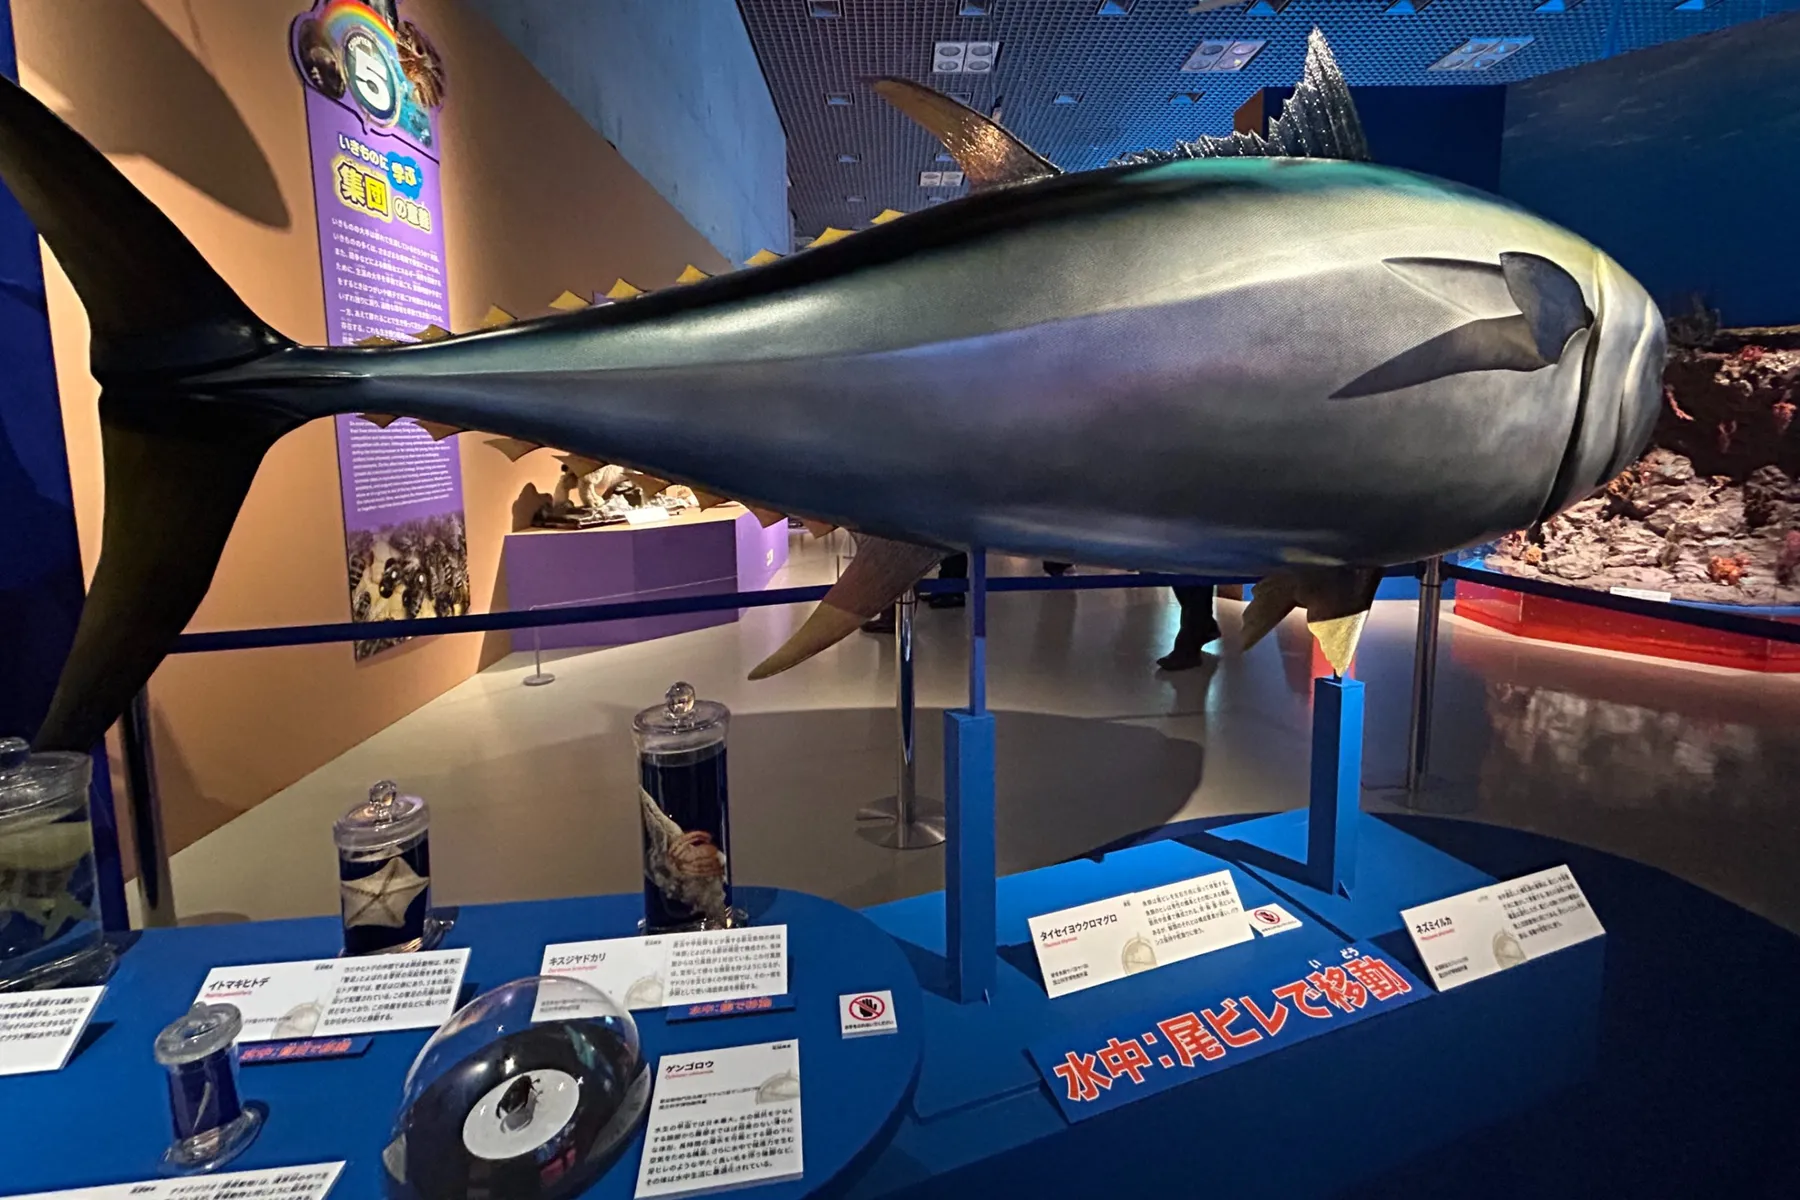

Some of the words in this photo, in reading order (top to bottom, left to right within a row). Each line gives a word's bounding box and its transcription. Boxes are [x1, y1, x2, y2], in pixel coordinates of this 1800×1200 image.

[355, 51, 390, 112] 5
[338, 162, 389, 217] 集団
[1040, 913, 1118, 942] タイセイヨウクロマグロ
[1416, 916, 1453, 934] ネズミイルカ
[549, 952, 606, 967] キスジヤドカリ
[208, 977, 271, 991] イトマキヒトデ
[1053, 955, 1413, 1102] 水中：尾ビレで移動
[665, 1060, 714, 1074] ゲンゴロウ
